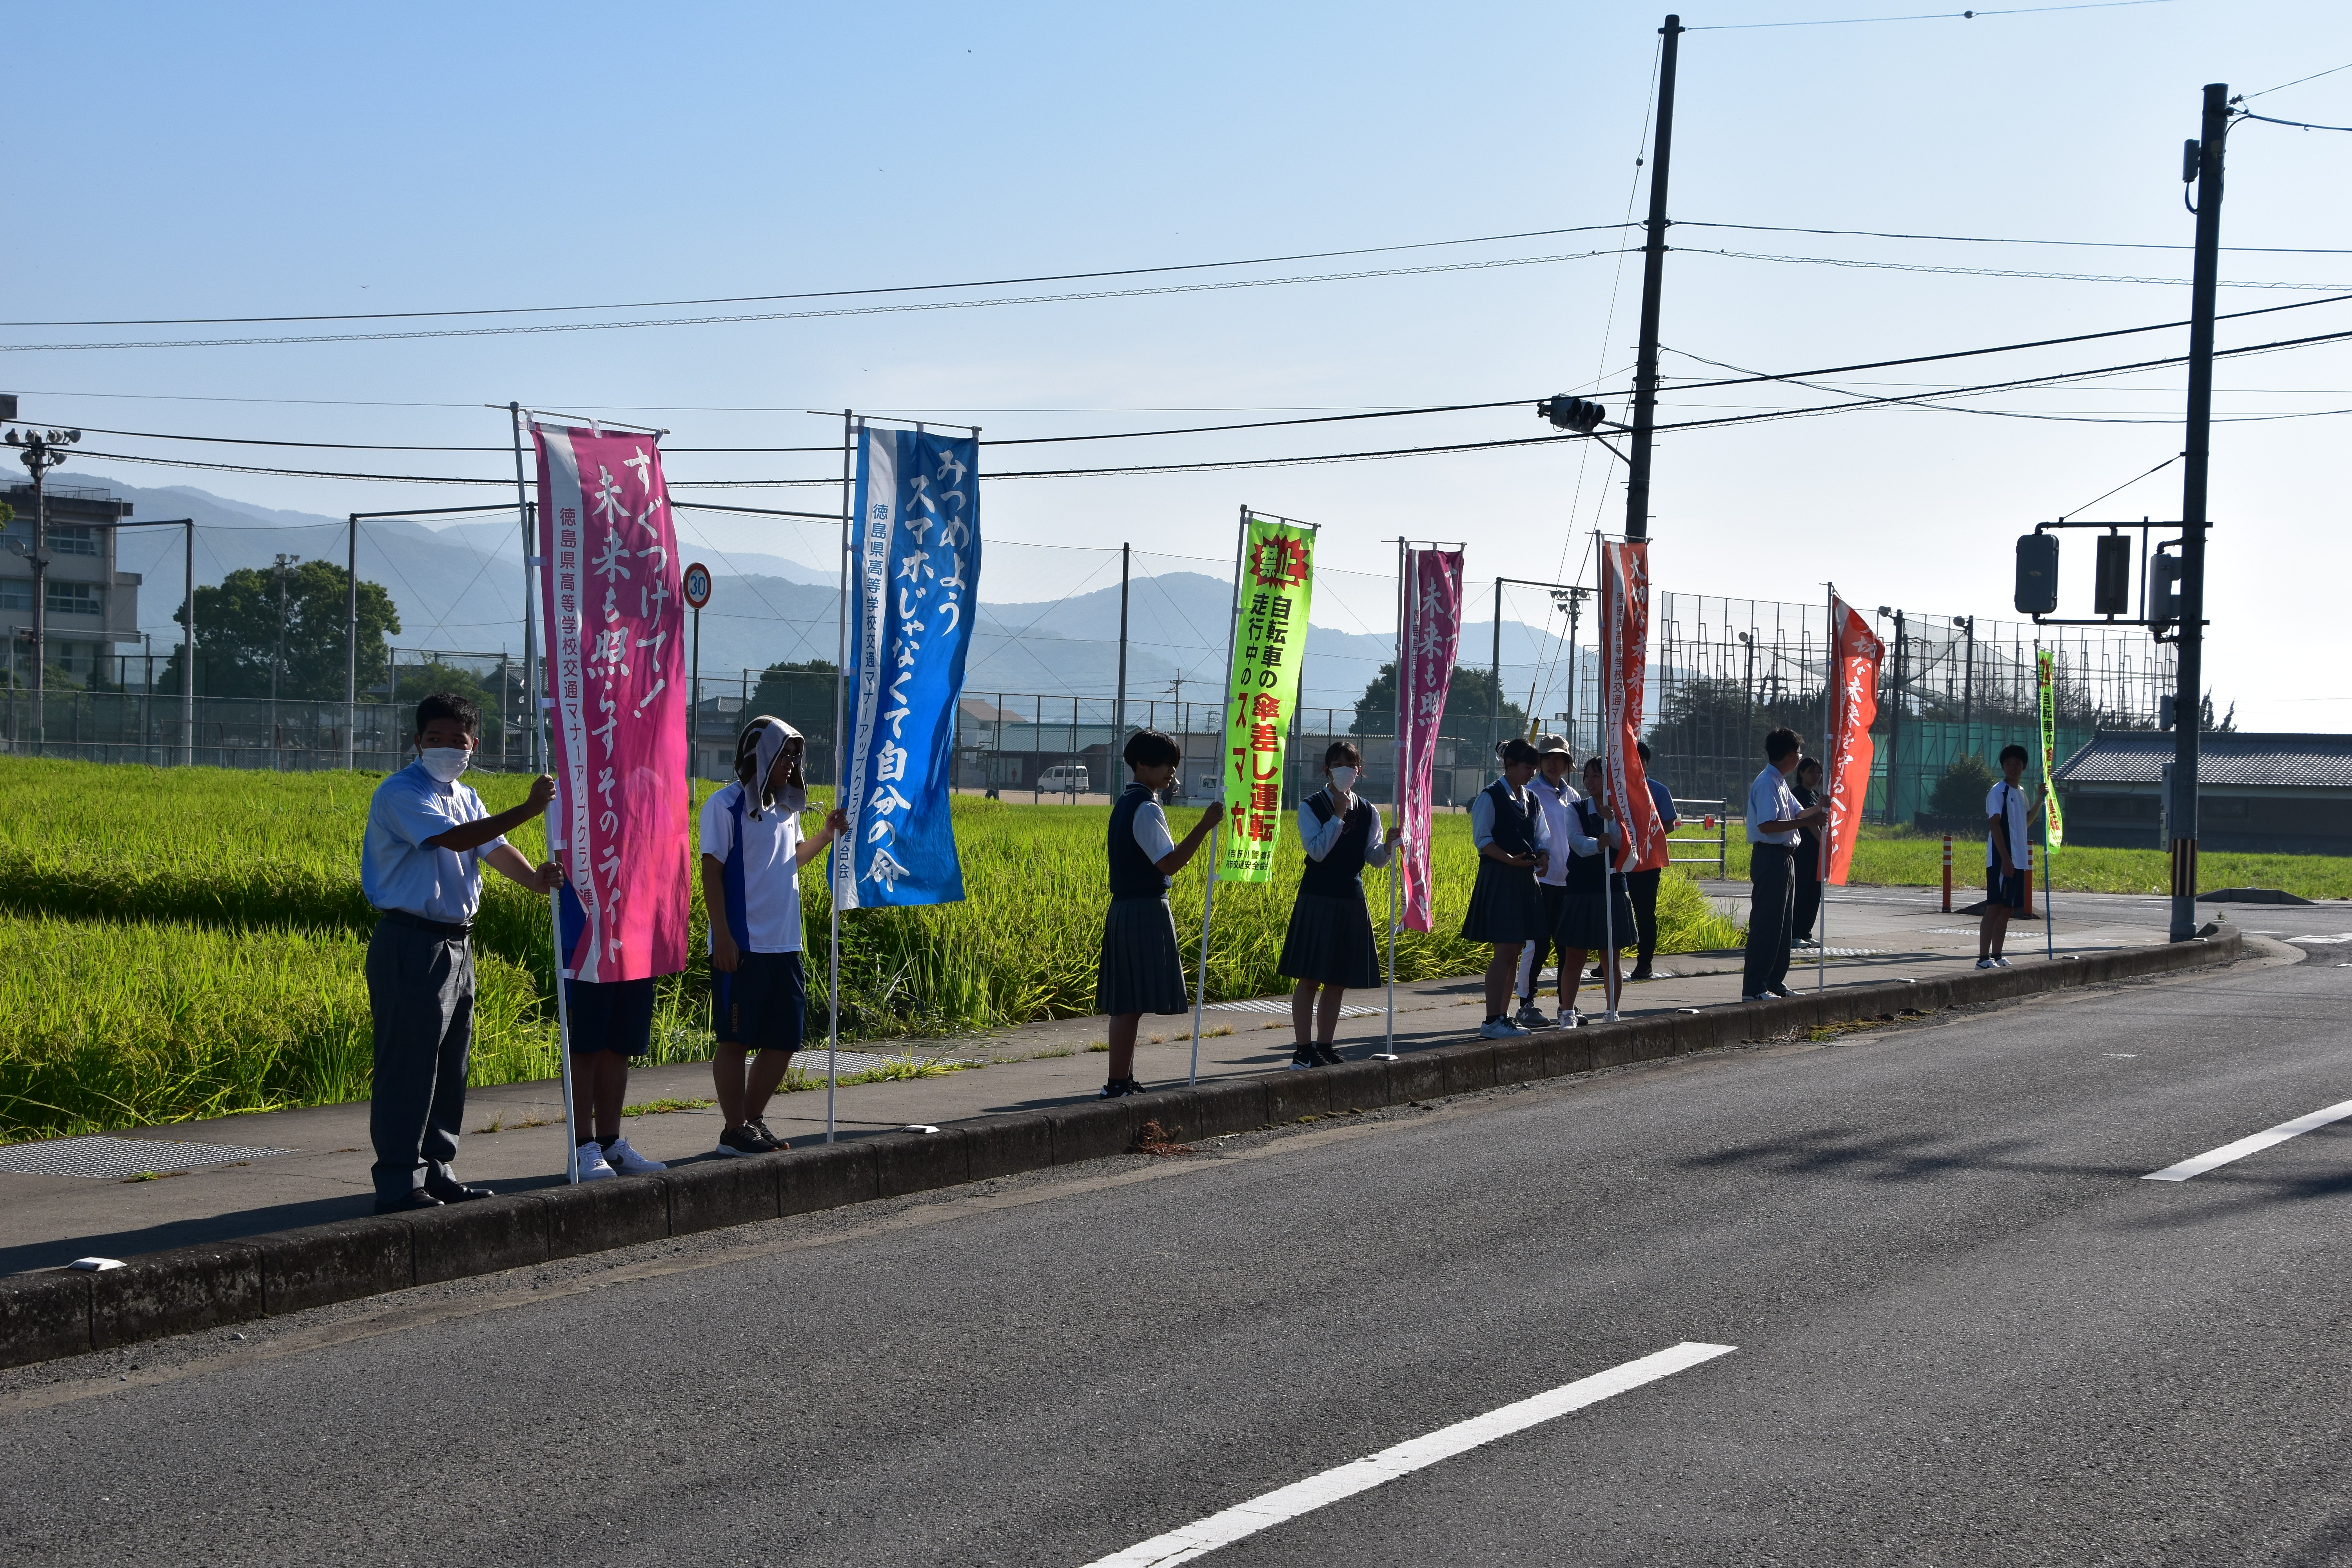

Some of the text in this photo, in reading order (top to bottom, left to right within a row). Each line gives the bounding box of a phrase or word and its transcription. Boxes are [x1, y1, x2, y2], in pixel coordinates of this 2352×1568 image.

[690, 575, 705, 596] 30
[839, 503, 888, 878] 徳島県高等学校交通マナーアップクラブ連合会
[859, 475, 935, 892] スマホじゃなくて自分の命
[937, 450, 969, 637] みつめよう
[1259, 544, 1297, 582] 禁止
[559, 507, 593, 906] 徳島県高等学校交通マナーアップクラブ連
[587, 465, 631, 964] 未来も照らすそのライト
[1248, 595, 1292, 842] 自転車の傘差し運転
